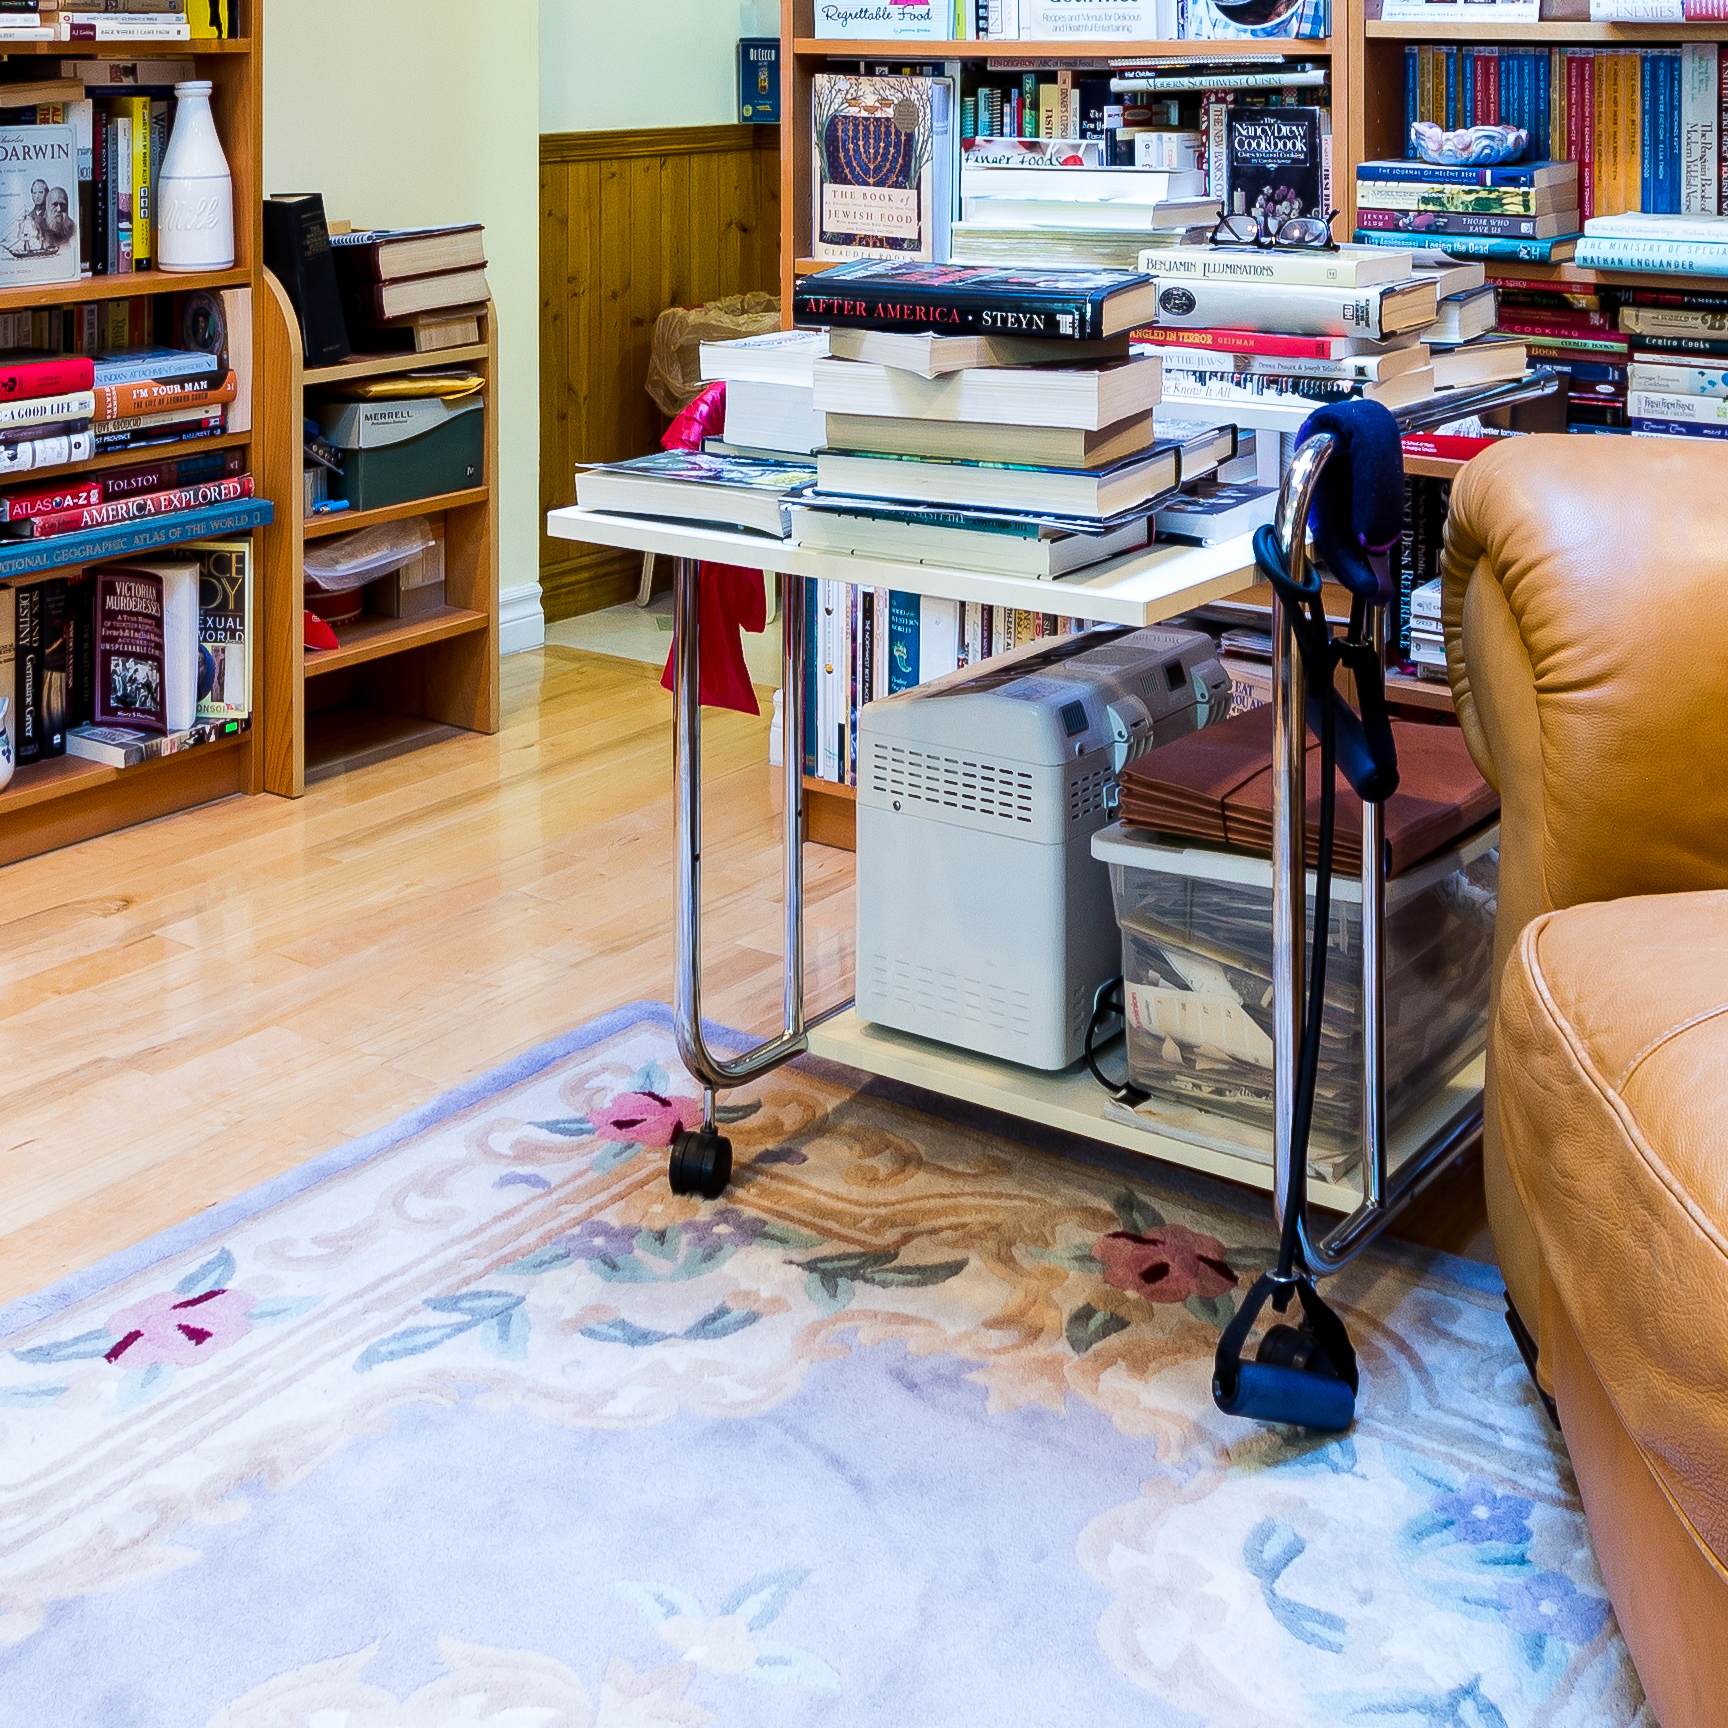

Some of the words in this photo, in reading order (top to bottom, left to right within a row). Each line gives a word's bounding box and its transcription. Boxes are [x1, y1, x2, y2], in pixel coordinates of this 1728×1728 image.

[822, 7, 893, 27] Regrettable
[897, 5, 932, 23] Food
[1234, 123, 1269, 140] Nancy
[1274, 123, 1306, 139] Drew
[1235, 137, 1307, 152] Cookbook
[1145, 257, 1198, 273] BENJAMIN
[1202, 260, 1275, 278] ILLUMINATIONS
[806, 298, 867, 319] AFTER
[875, 301, 960, 323] AMERICA
[982, 311, 1045, 330] STEYN
[363, 410, 413, 423] MERRELL
[105, 473, 160, 493] TOLSTOY
[80, 497, 155, 528] AMERICA
[161, 481, 241, 512] EXPLORED
